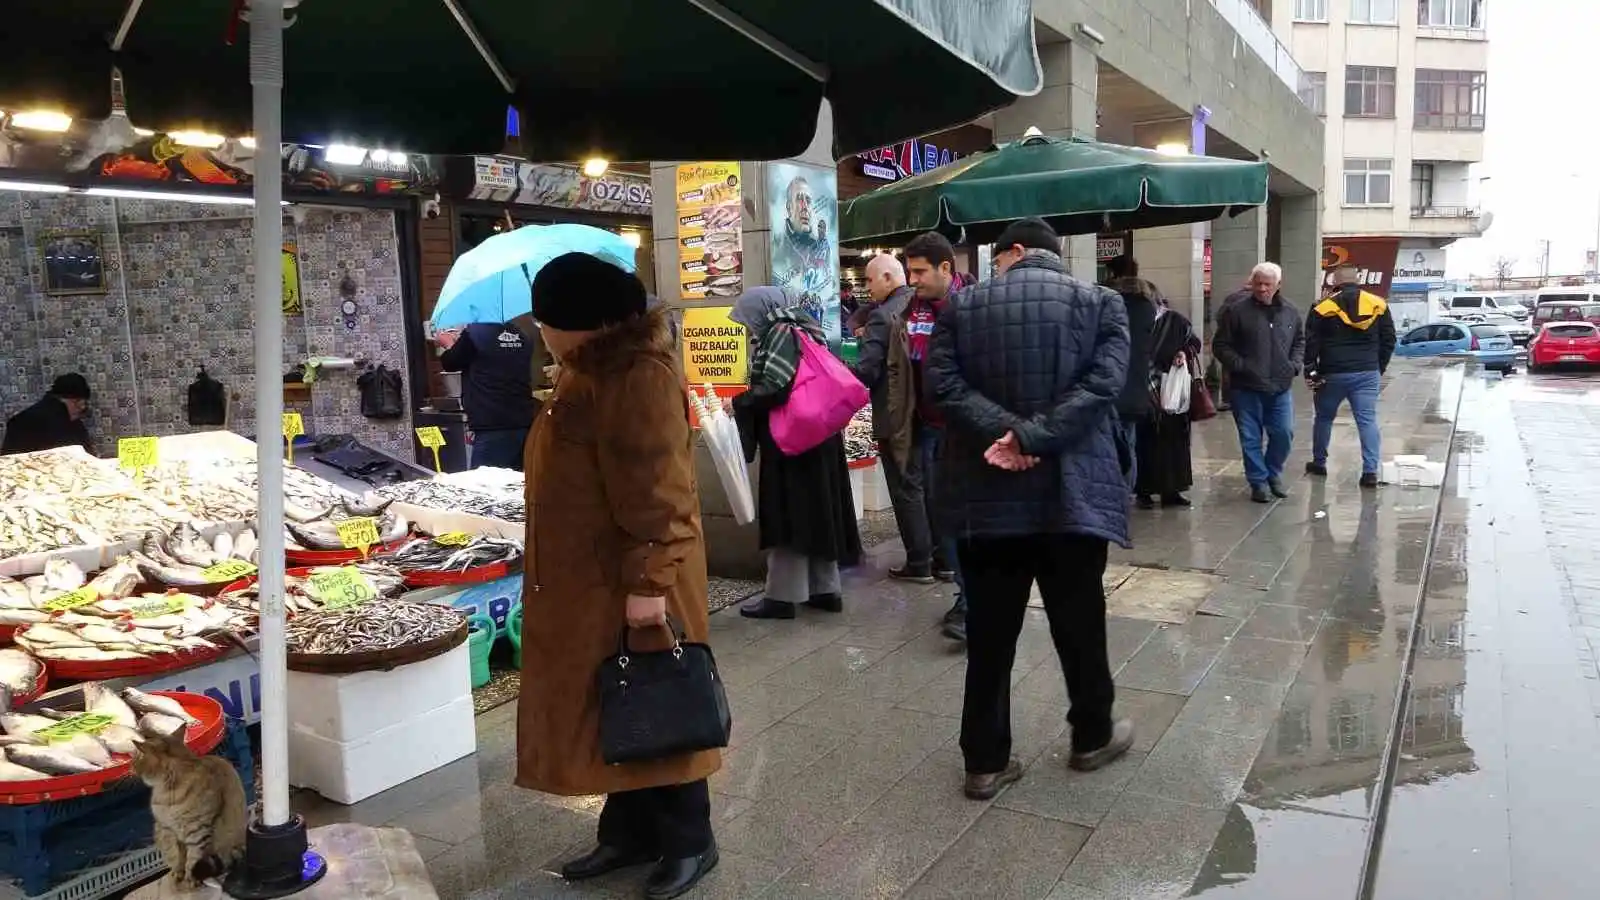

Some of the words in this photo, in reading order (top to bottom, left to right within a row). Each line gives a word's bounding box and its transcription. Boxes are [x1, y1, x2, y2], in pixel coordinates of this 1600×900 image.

[593, 178, 623, 200] ÖZ
[683, 327, 716, 338] IZGARA
[717, 326, 745, 337] BALIK
[689, 341, 708, 352] BUZ
[709, 338, 739, 351] BALIĞI
[692, 354, 738, 364] USKUMRU
[698, 367, 732, 377] VARDIR
